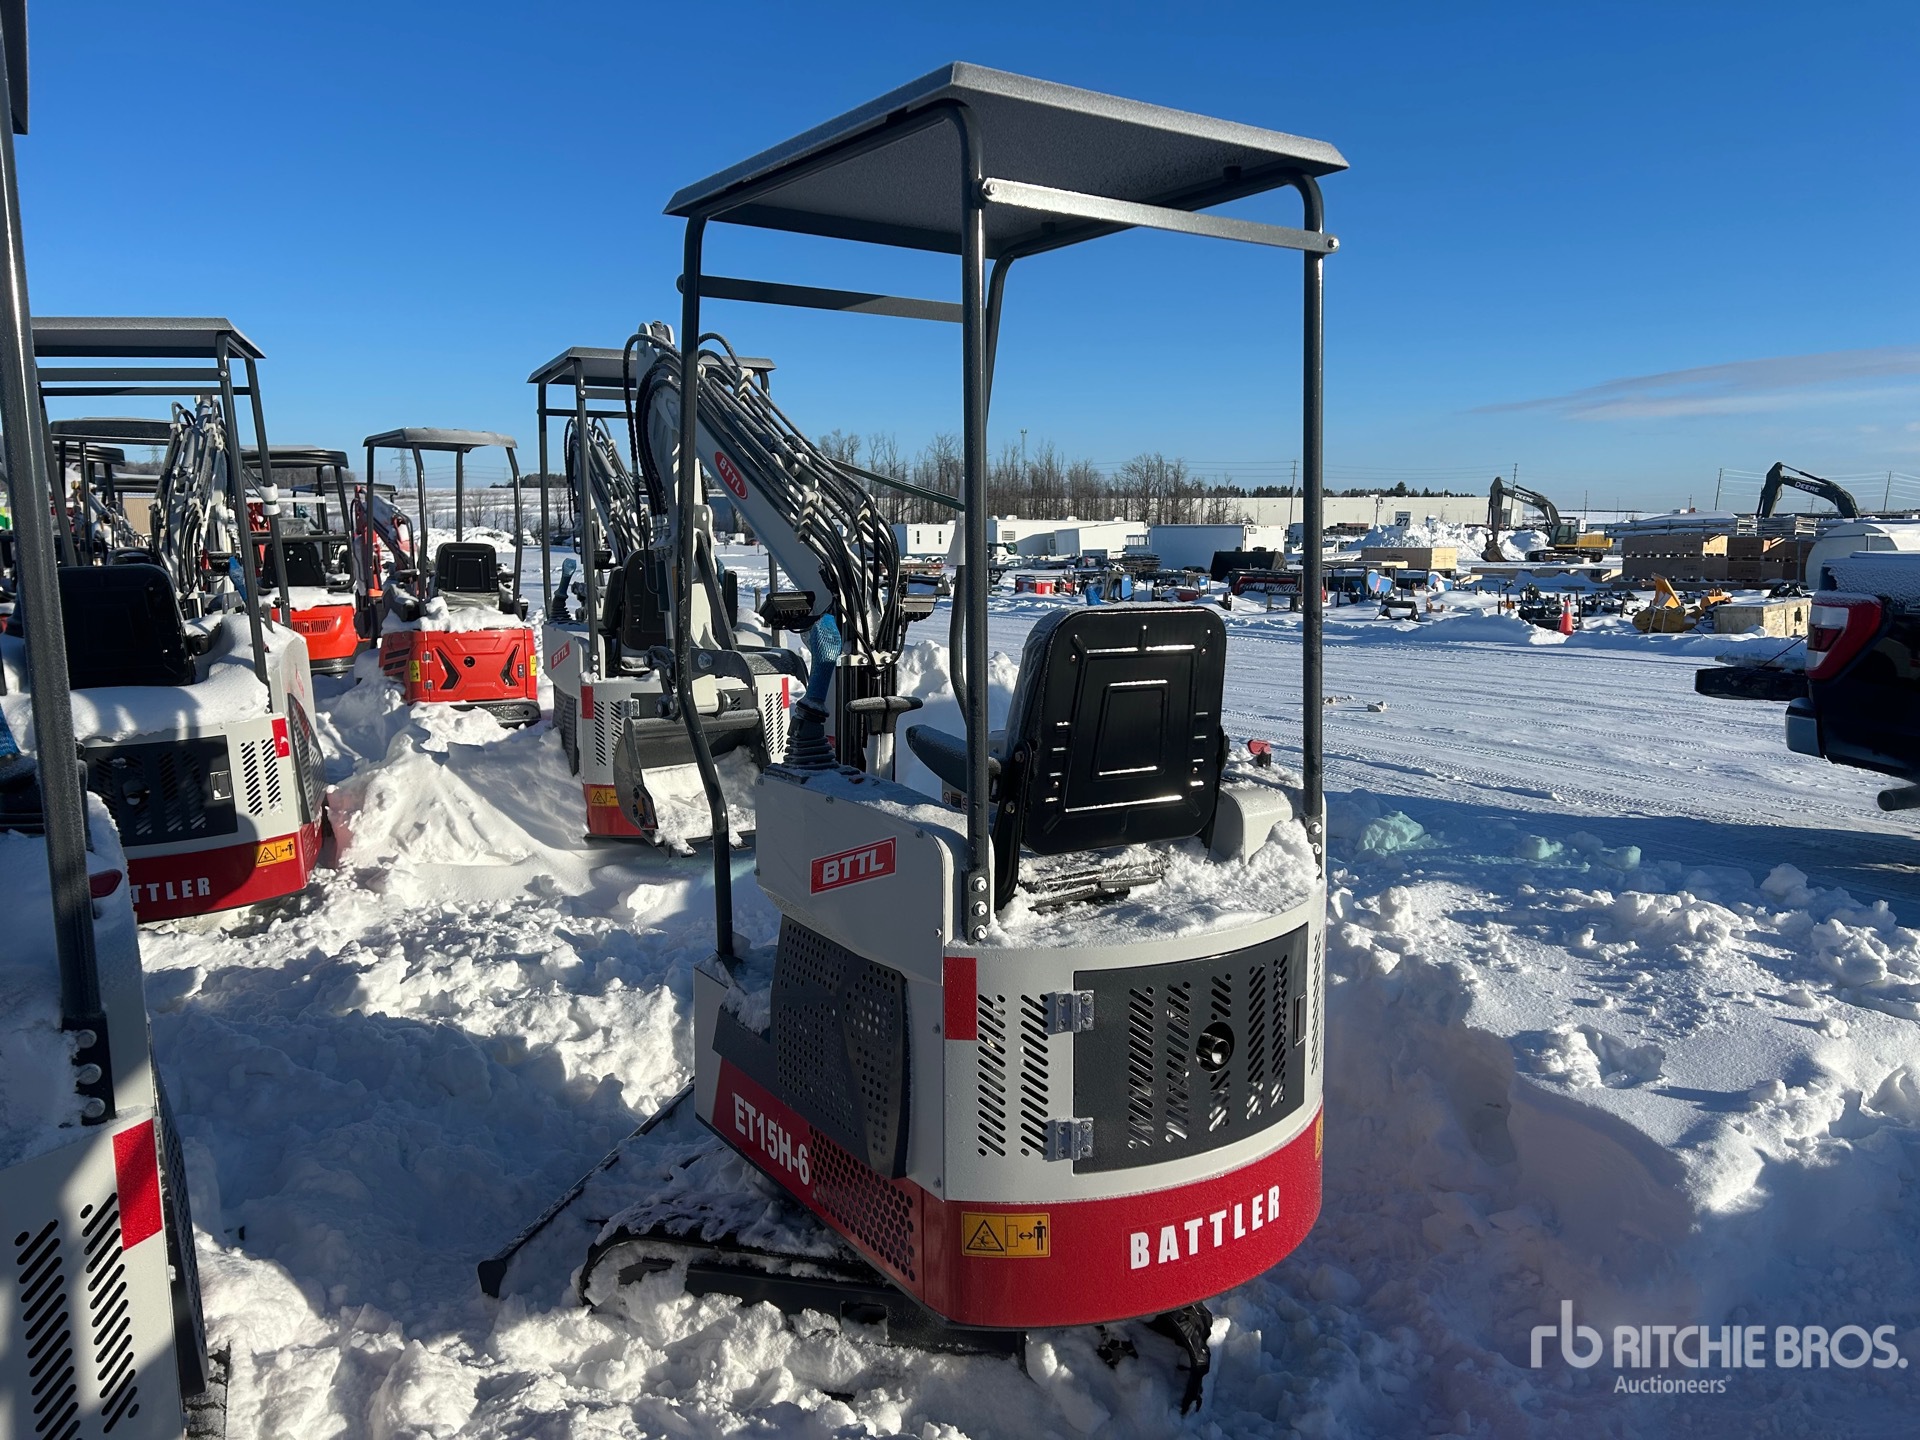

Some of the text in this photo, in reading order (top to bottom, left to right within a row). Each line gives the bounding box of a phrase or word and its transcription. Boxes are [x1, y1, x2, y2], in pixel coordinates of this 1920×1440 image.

[719, 457, 741, 494] BTTL
[1794, 481, 1820, 493] DEERE
[1514, 492, 1535, 503] DEERE
[1396, 518, 1409, 527] 27
[553, 647, 568, 666] BTTL
[823, 849, 884, 884] BTTL
[130, 877, 211, 904] TTLER
[734, 1093, 810, 1186] ET15H-6
[1130, 1185, 1280, 1270] BATTLER
